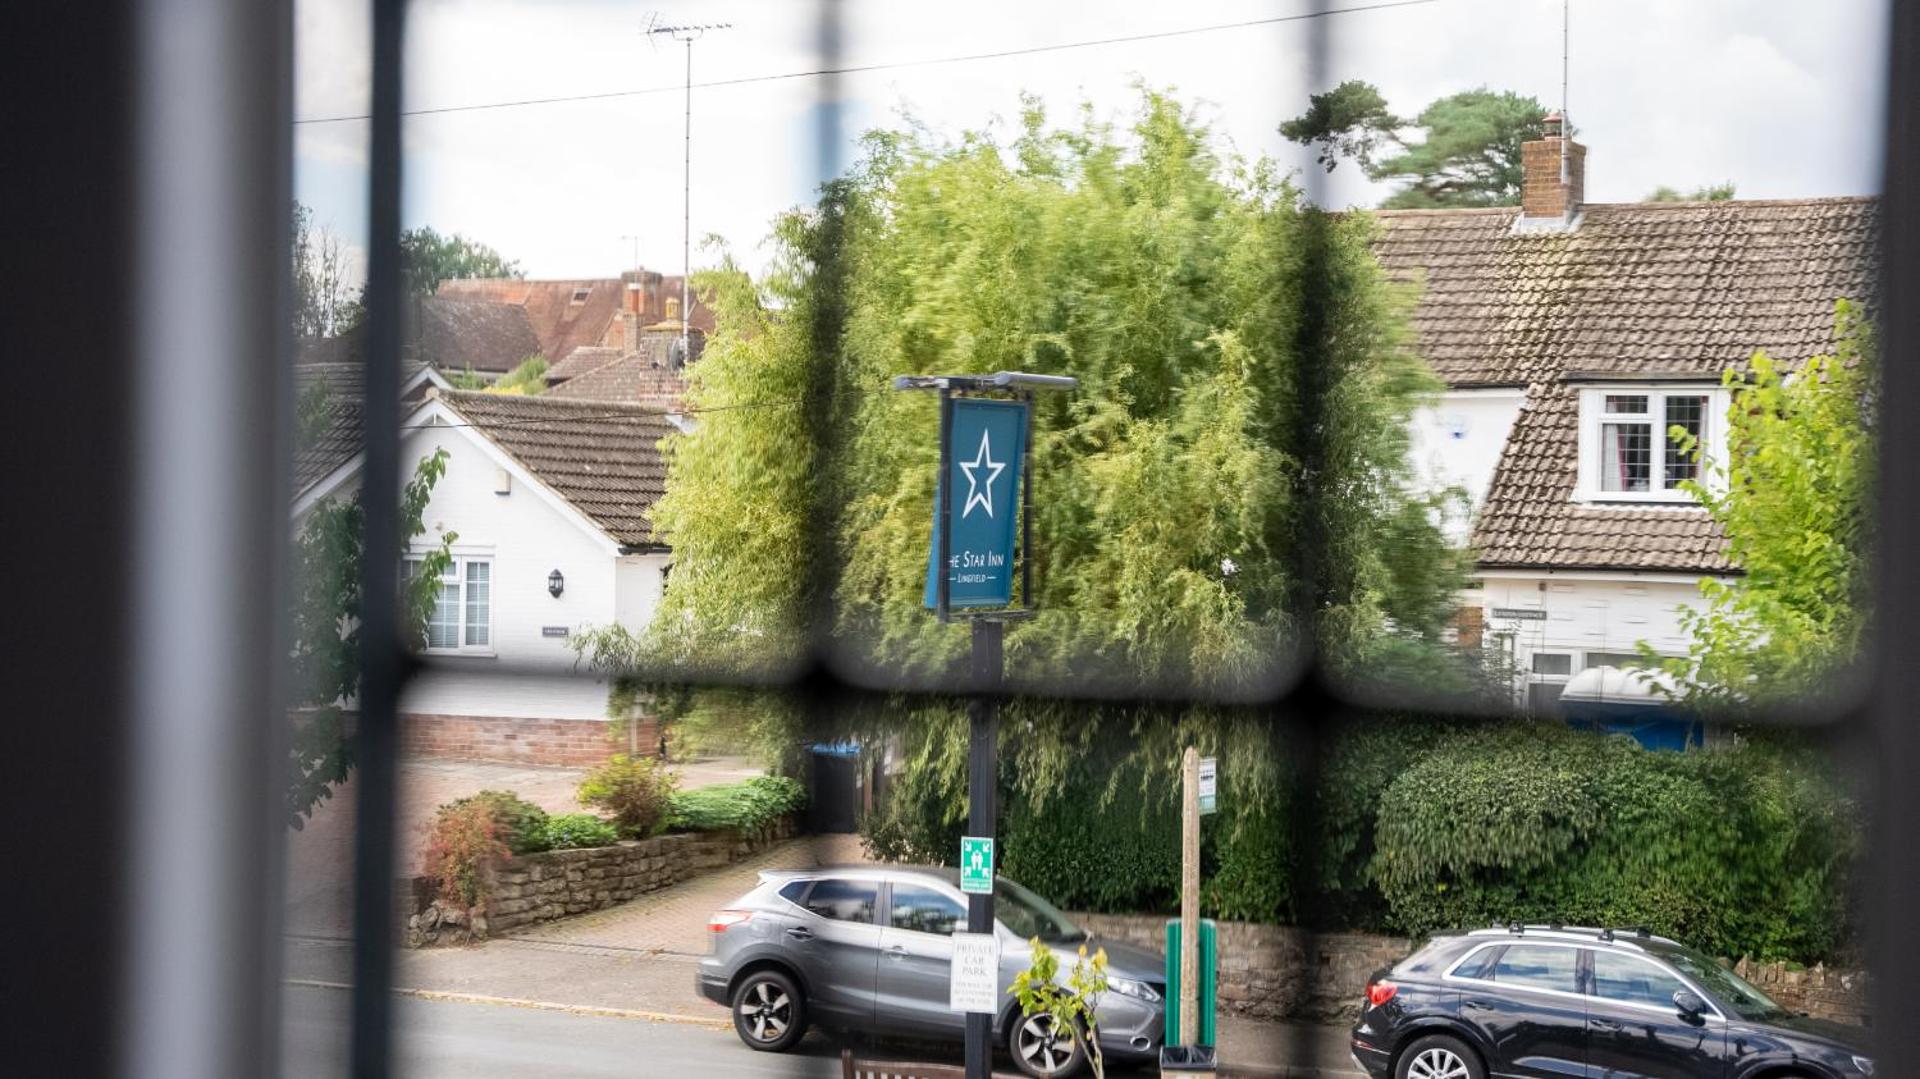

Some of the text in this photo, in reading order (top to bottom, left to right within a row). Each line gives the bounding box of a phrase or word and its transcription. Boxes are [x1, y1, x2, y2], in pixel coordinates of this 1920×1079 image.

[963, 550, 985, 568] STAR
[988, 549, 1004, 567] INN
[956, 943, 992, 953] PRIVATE
[964, 955, 984, 965] CAR
[962, 966, 987, 976] PARK
